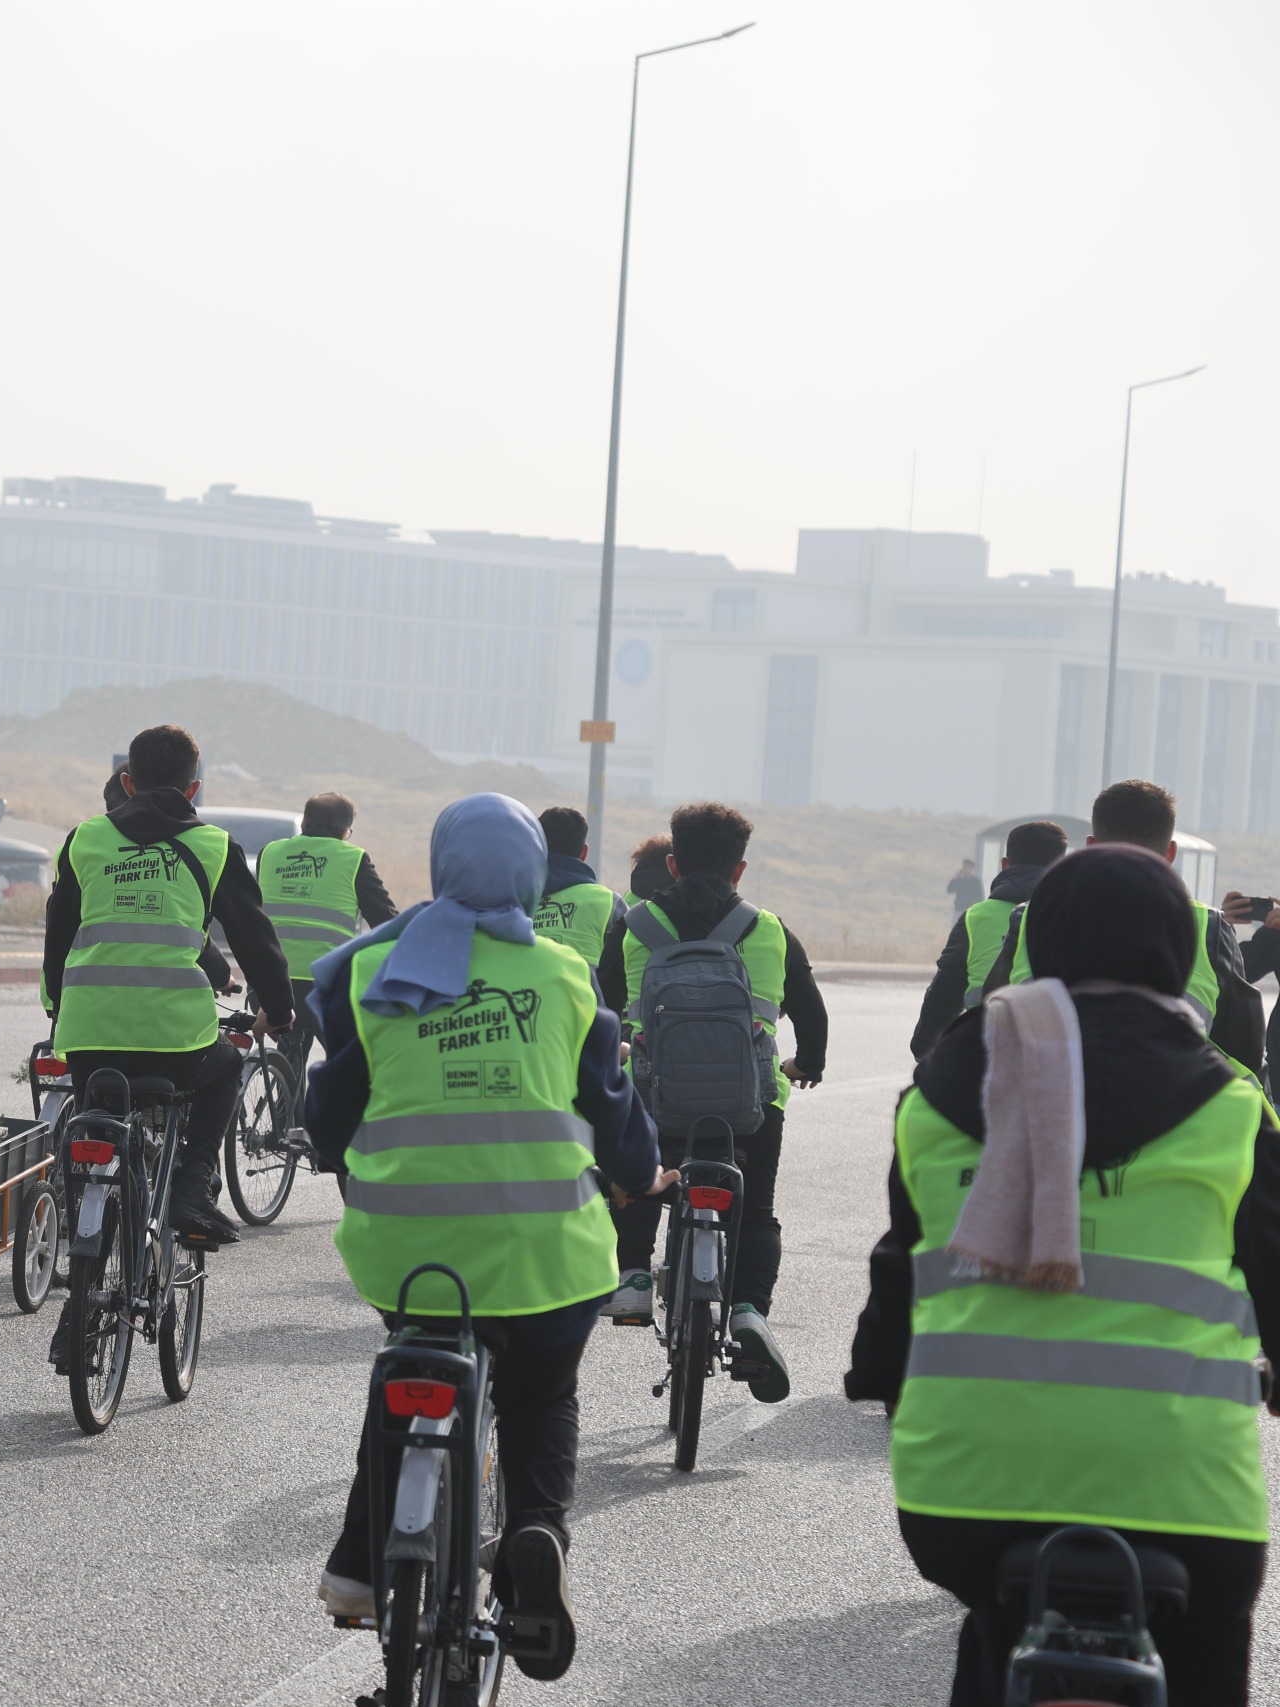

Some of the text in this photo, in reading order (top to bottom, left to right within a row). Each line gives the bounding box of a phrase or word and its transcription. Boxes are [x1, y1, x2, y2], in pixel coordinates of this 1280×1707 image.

[104, 858, 160, 876] Bisikletliyi
[114, 869, 160, 885] FARK ET!
[282, 872, 300, 880] FARK
[534, 911, 558, 921] letliyi
[546, 919, 559, 928] ET!
[418, 1006, 507, 1039] Bisikletliyi
[438, 1026, 510, 1053] FARK ET!
